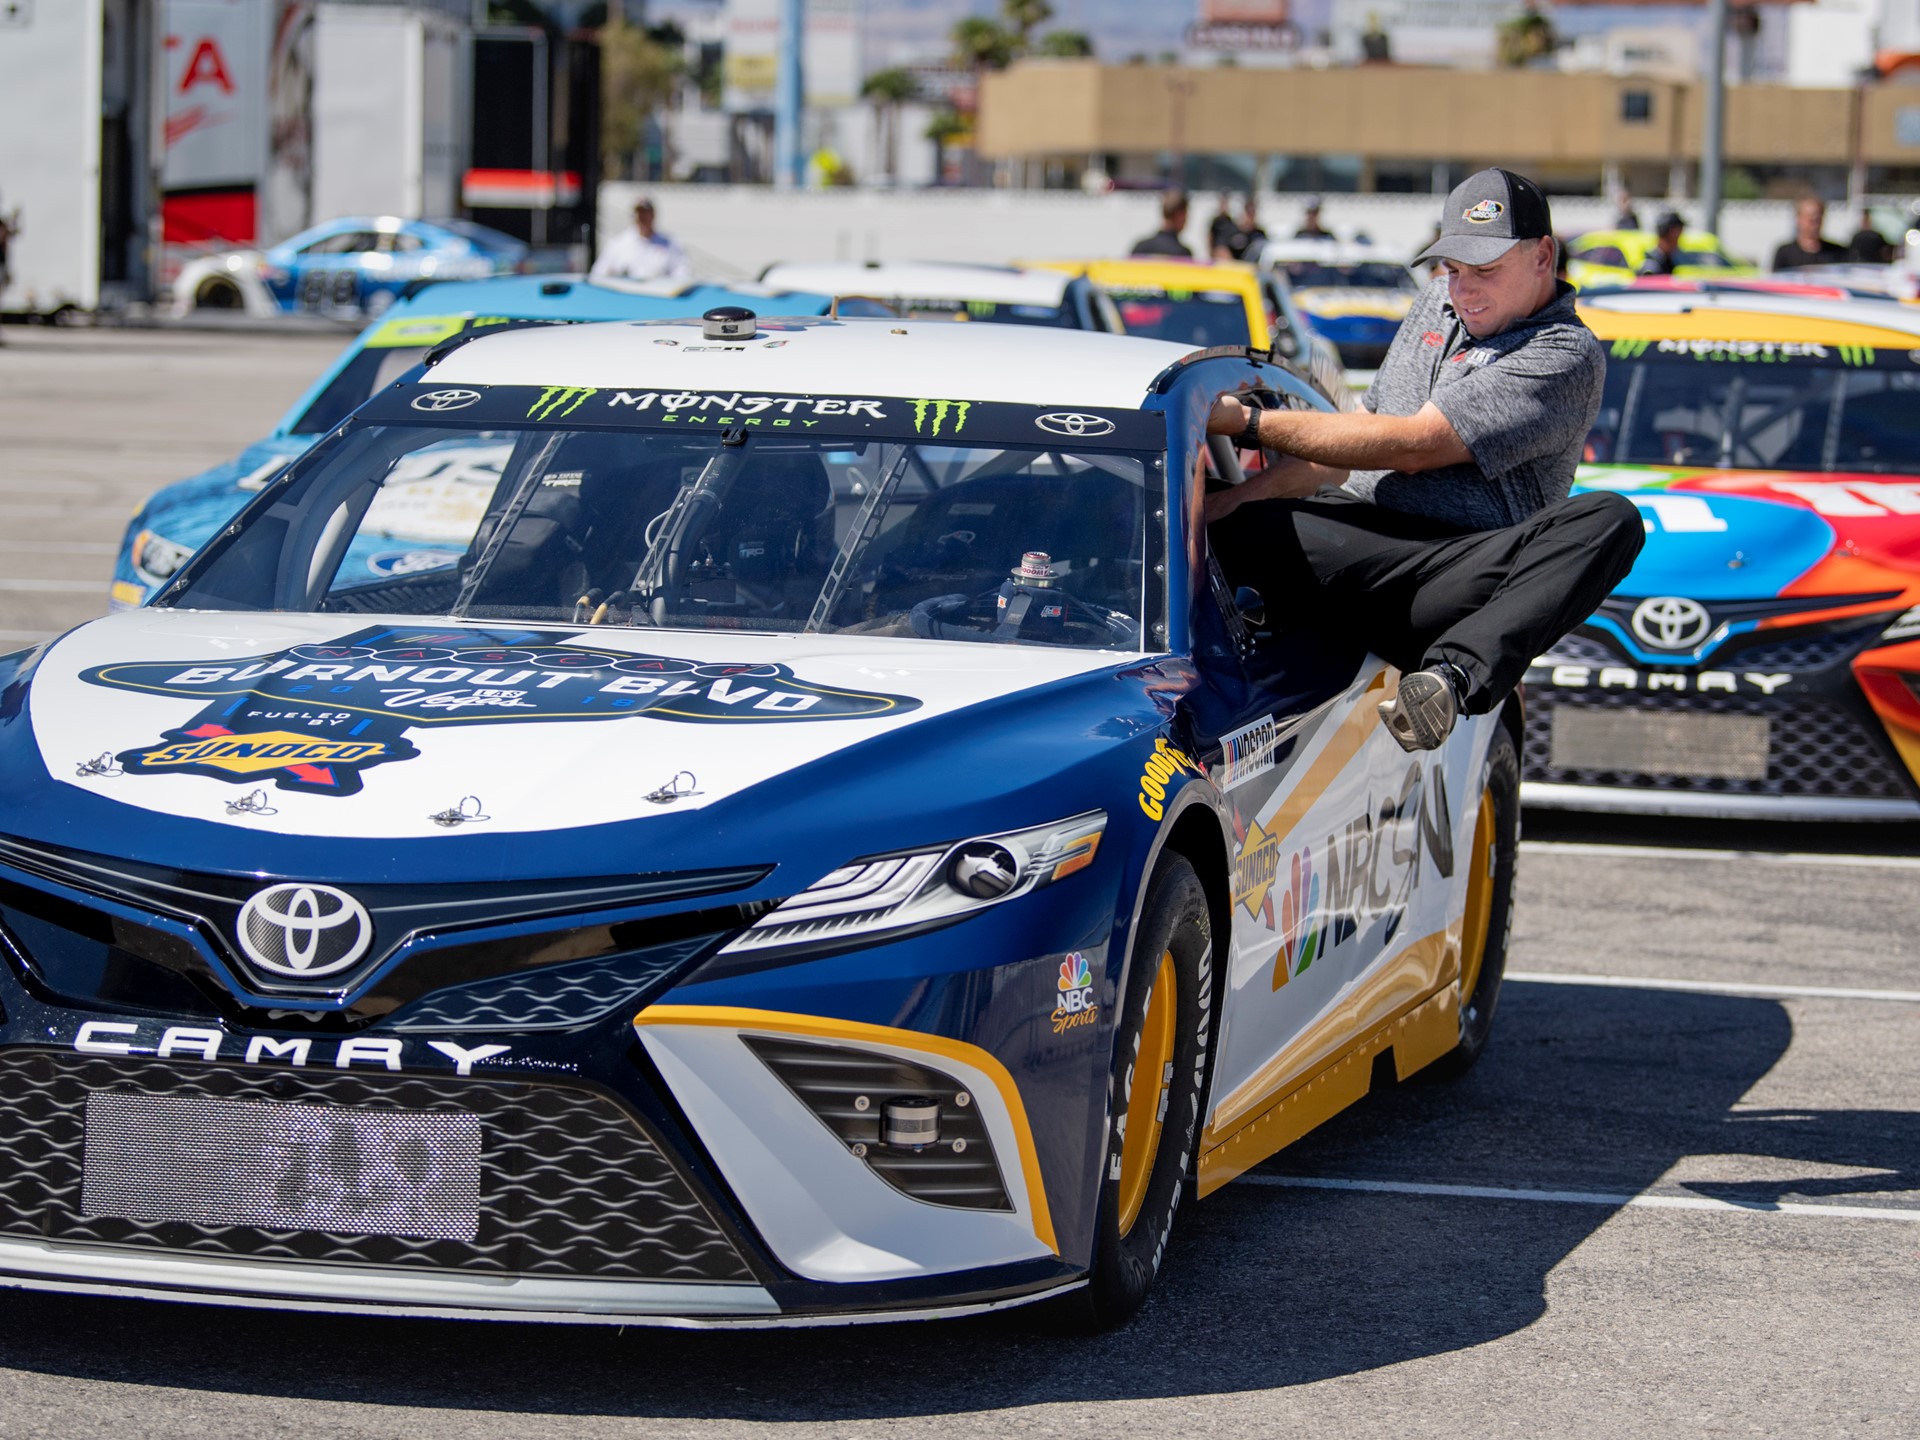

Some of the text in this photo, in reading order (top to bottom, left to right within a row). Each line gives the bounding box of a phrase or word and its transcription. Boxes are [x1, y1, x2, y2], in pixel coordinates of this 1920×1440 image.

[608, 390, 887, 419] MONSTER
[662, 414, 819, 428] ENERGY
[163, 659, 822, 711] BURNOUT BLVD
[1552, 665, 1792, 694] CAMRY
[247, 711, 351, 720] FUELED
[157, 741, 377, 763] SUNOCO
[1235, 720, 1276, 781] NASCAR
[1235, 841, 1276, 898] SUNOCO
[1057, 987, 1094, 1013] NBC
[1051, 1005, 1098, 1036] Sports
[74, 1020, 512, 1076] CAMRY
